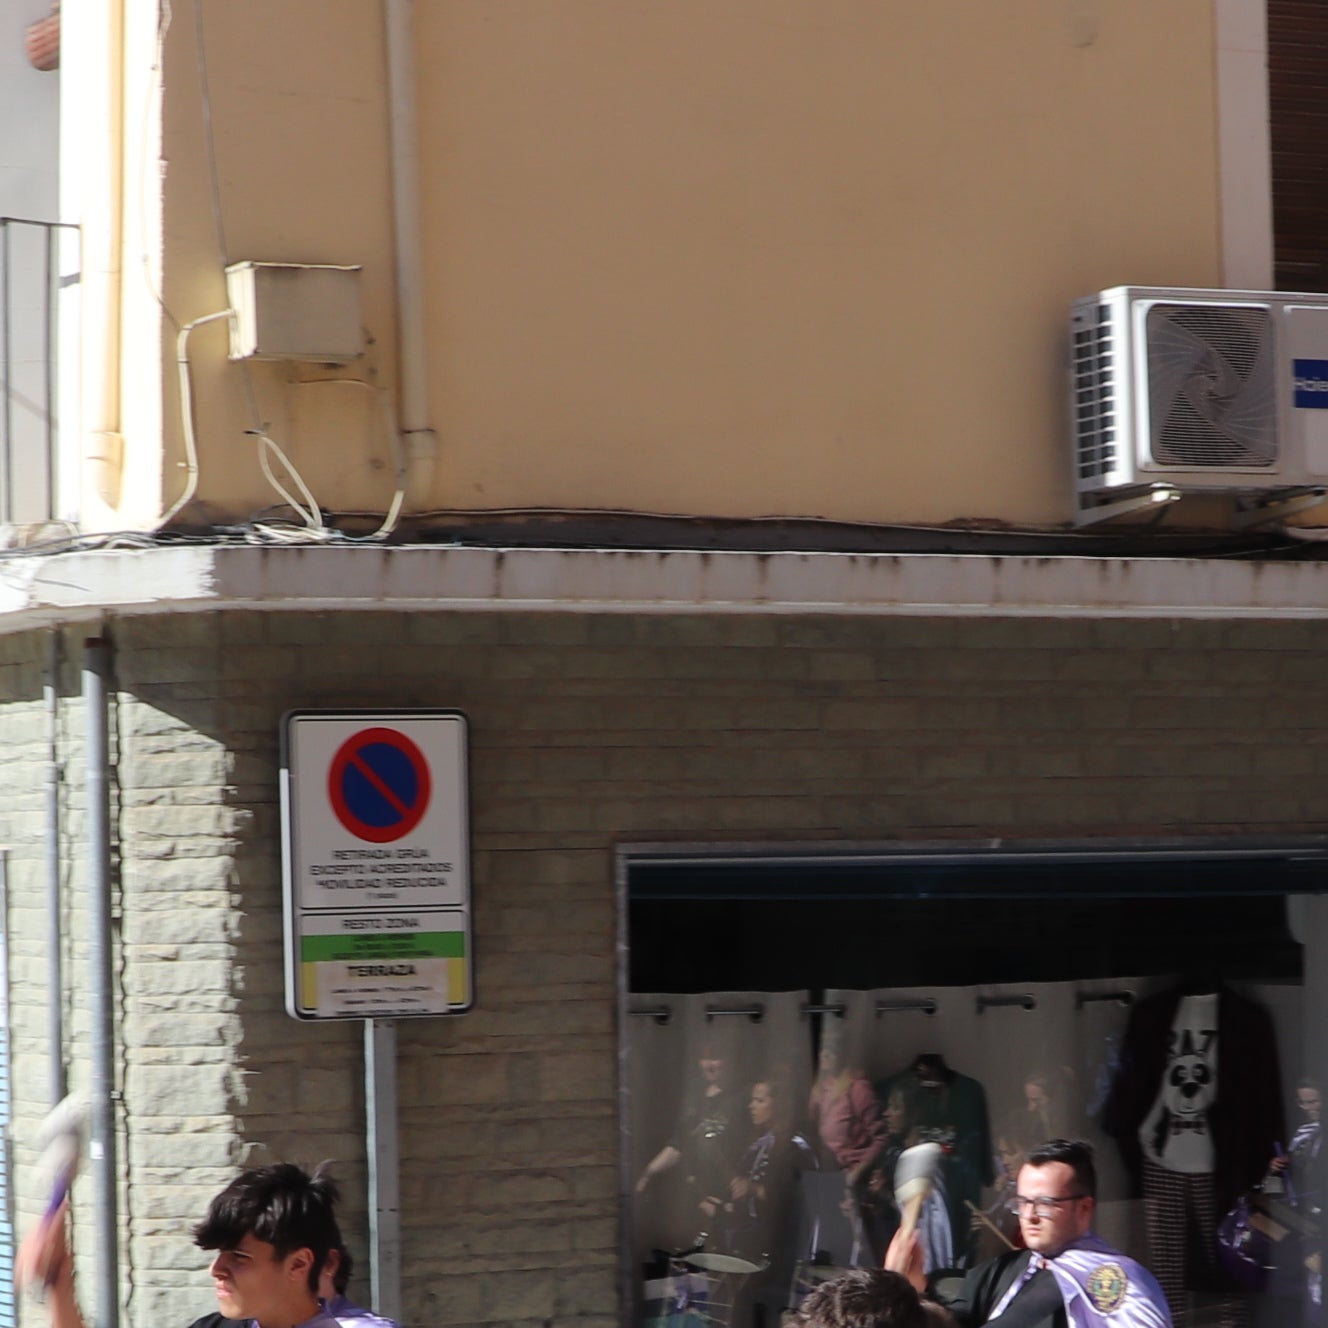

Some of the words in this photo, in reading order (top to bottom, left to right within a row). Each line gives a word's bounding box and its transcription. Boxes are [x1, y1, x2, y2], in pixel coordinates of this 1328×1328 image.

[332, 849, 392, 860] RETIRADA
[309, 864, 366, 876] EXCEPTO
[369, 862, 454, 874] ACREDITADOS
[315, 878, 382, 889] MOVILIDAD
[386, 877, 447, 888] REDUCIDA
[342, 918, 382, 929] RESTO
[386, 917, 421, 928] ZONA
[346, 963, 417, 977] TERRAZA
